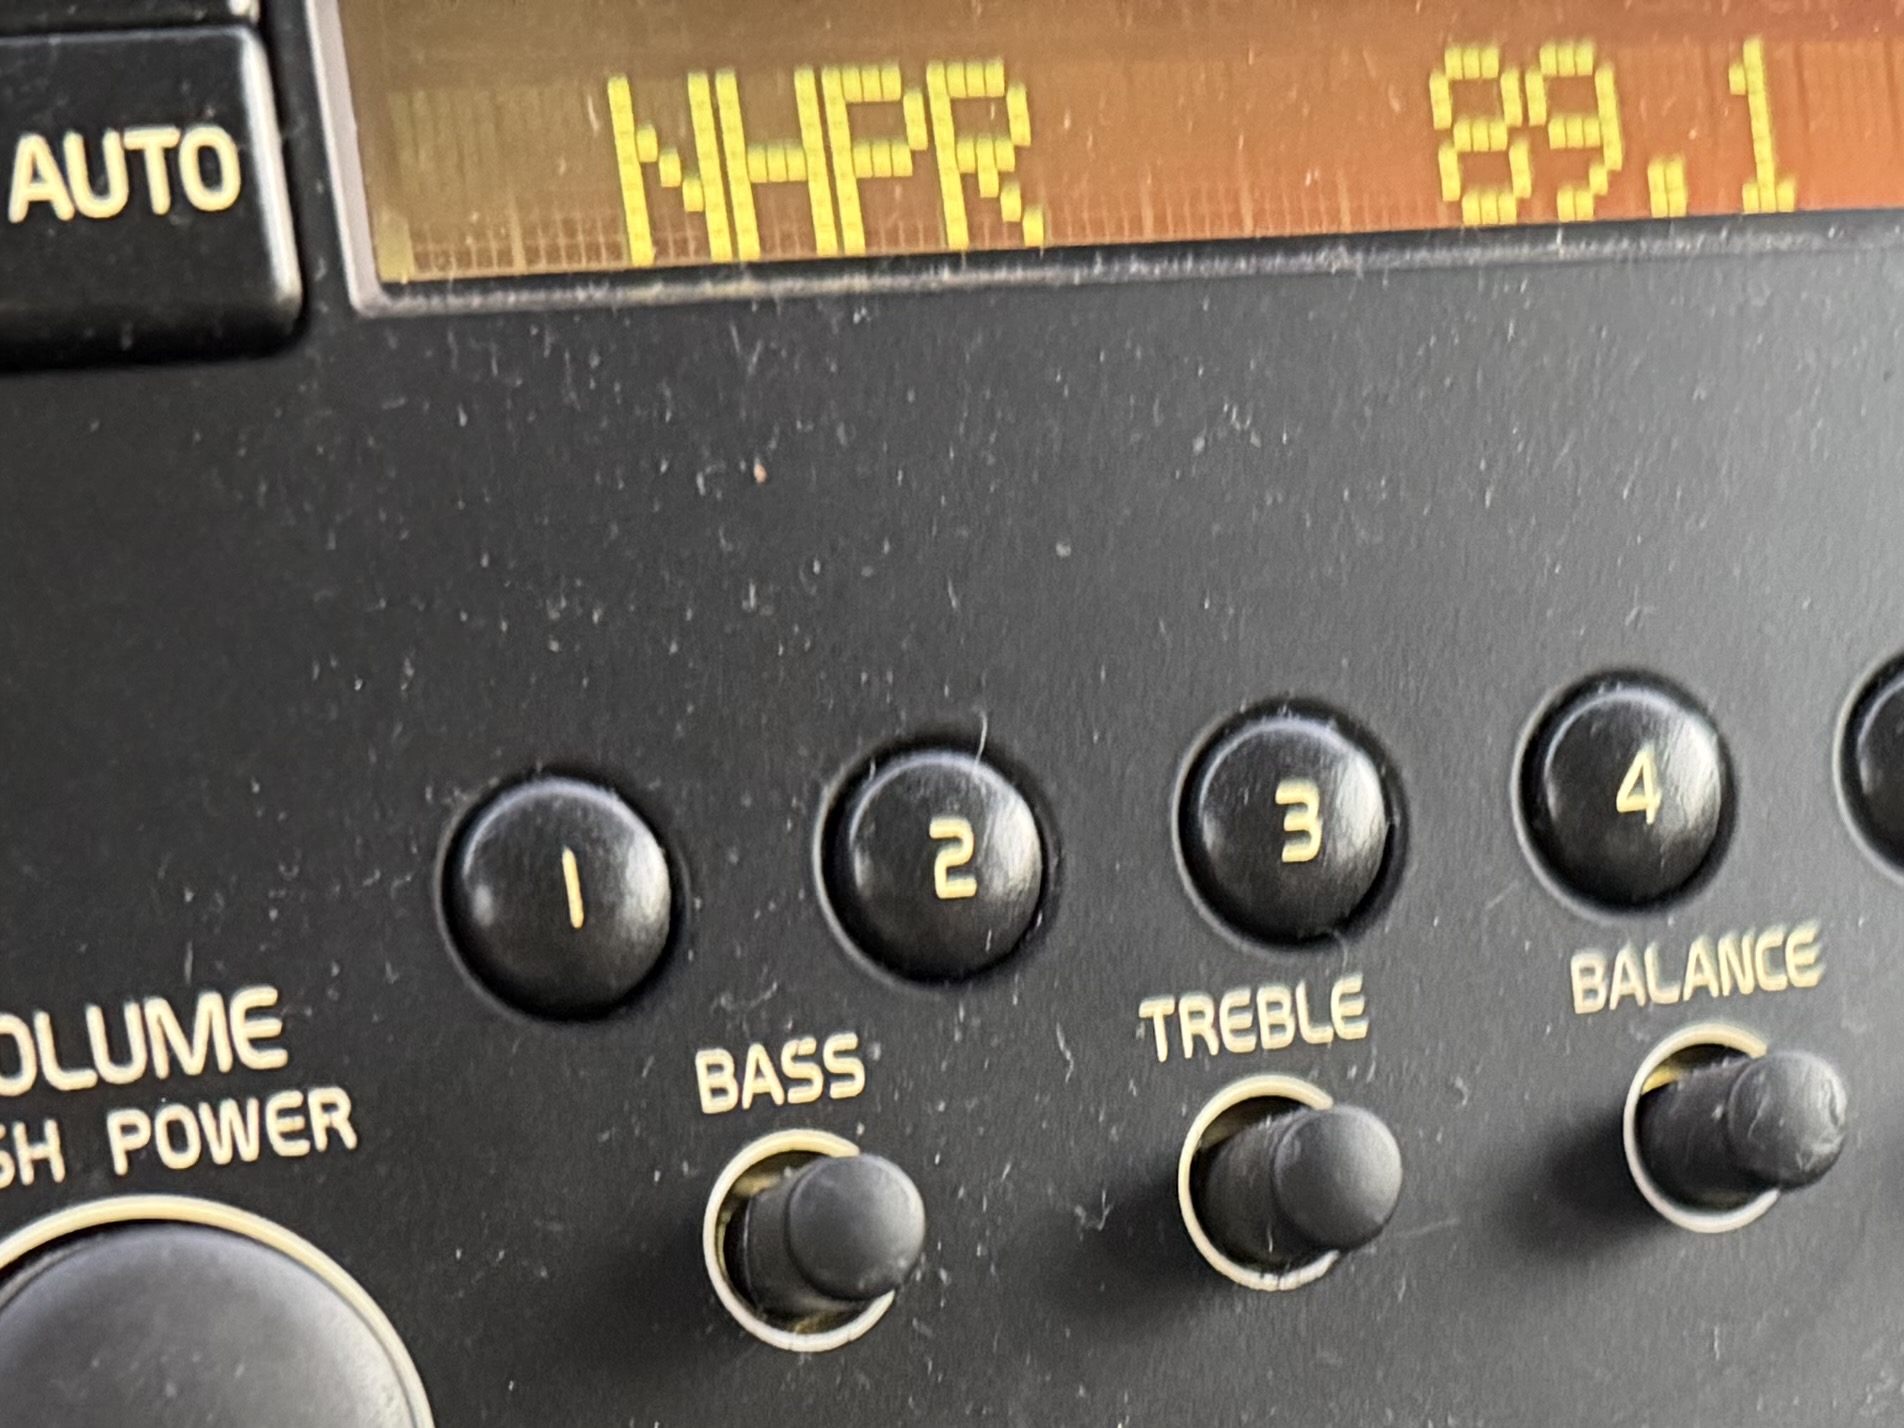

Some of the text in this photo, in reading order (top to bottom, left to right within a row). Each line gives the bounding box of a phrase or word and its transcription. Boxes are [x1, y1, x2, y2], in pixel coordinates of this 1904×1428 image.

[8, 125, 243, 225] AUTO
[607, 38, 1796, 266] NHPR 89.1
[1275, 779, 1324, 863] 3
[1615, 748, 1662, 825] 4
[562, 847, 585, 929] 1
[929, 816, 977, 899] 2
[1569, 920, 1826, 1015] BALANCE
[1137, 973, 1370, 1063] TREBLE
[696, 1032, 866, 1115] BASS
[106, 1085, 358, 1176] POWER
